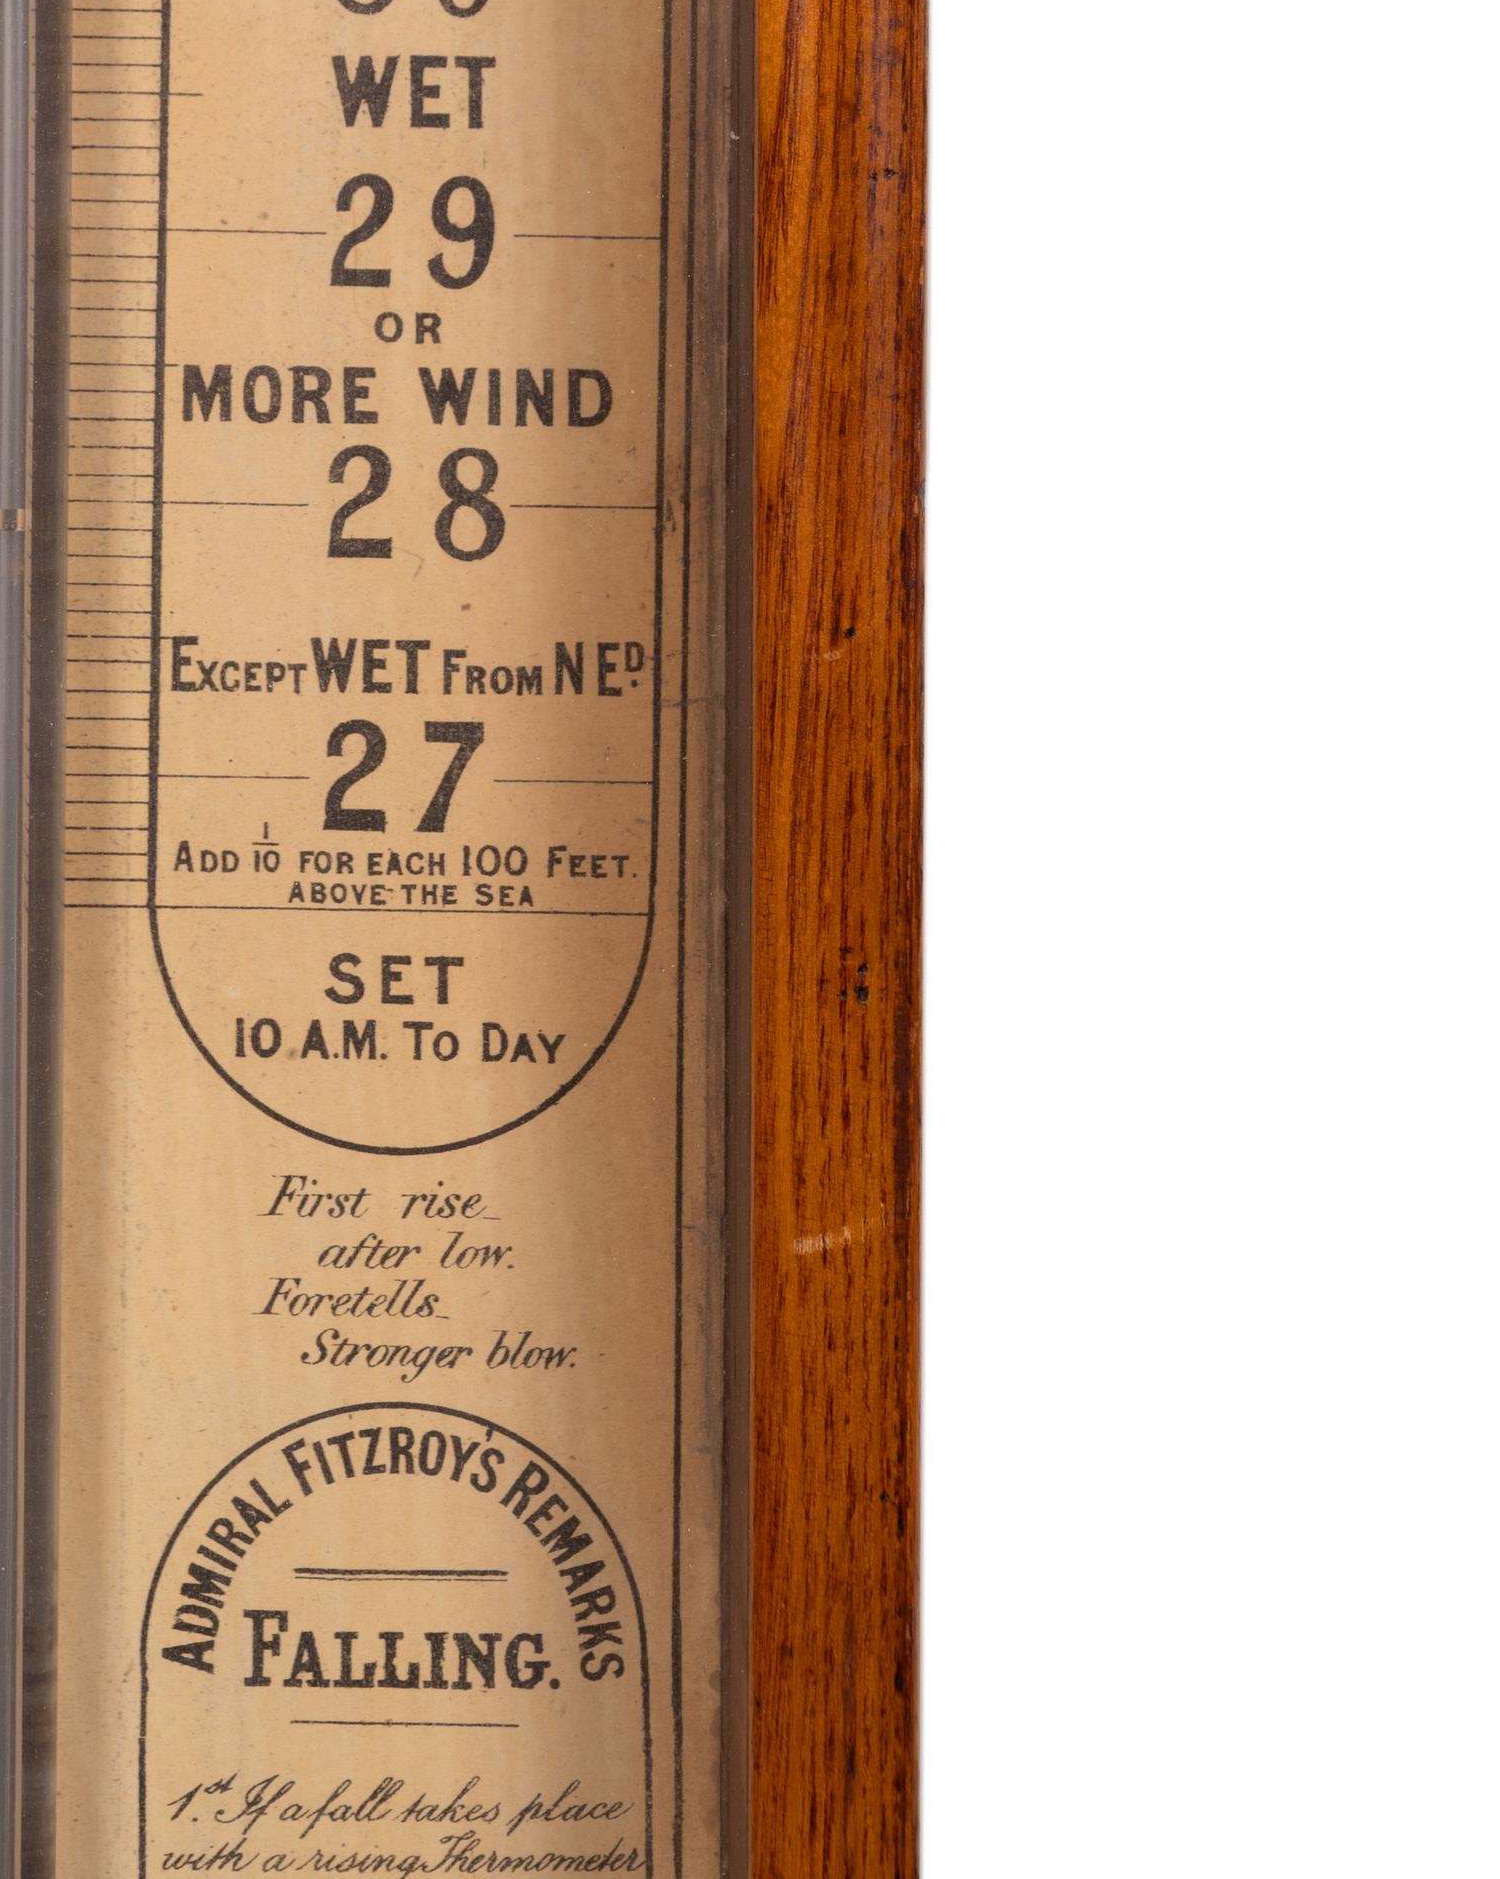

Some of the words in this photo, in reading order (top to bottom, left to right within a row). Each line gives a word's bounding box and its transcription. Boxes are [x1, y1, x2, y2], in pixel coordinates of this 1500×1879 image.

[331, 55, 496, 128] WET
[330, 173, 496, 290] 29
[374, 312, 442, 344] OR
[182, 364, 379, 424] MORE
[420, 367, 613, 427] WIND
[327, 444, 506, 562] 28
[311, 638, 430, 694] WET
[322, 719, 484, 833] 27
[300, 851, 353, 875] FOR
[367, 849, 446, 876] EACH
[462, 845, 528, 876] 100
[288, 881, 386, 904] ABOVE
[400, 883, 458, 905] THE
[475, 884, 534, 906] SEA
[324, 953, 464, 1005] SET
[300, 1019, 388, 1061] A.M.
[258, 1174, 371, 1218] First
[318, 1232, 421, 1270] after
[440, 1231, 514, 1269] low.
[300, 1328, 472, 1382] Stronger
[487, 1331, 577, 1369] blow.
[162, 1478, 292, 1674] ADMIRAL
[281, 1425, 505, 1496] FITZROY'S
[500, 1461, 625, 1682] REMARKS
[300, 1776, 402, 1838] fall
[401, 1776, 500, 1822] takes
[508, 1780, 633, 1835] place
[161, 1838, 259, 1872] with
[263, 1850, 295, 1871] a
[420, 1830, 645, 1873] Thermometer
